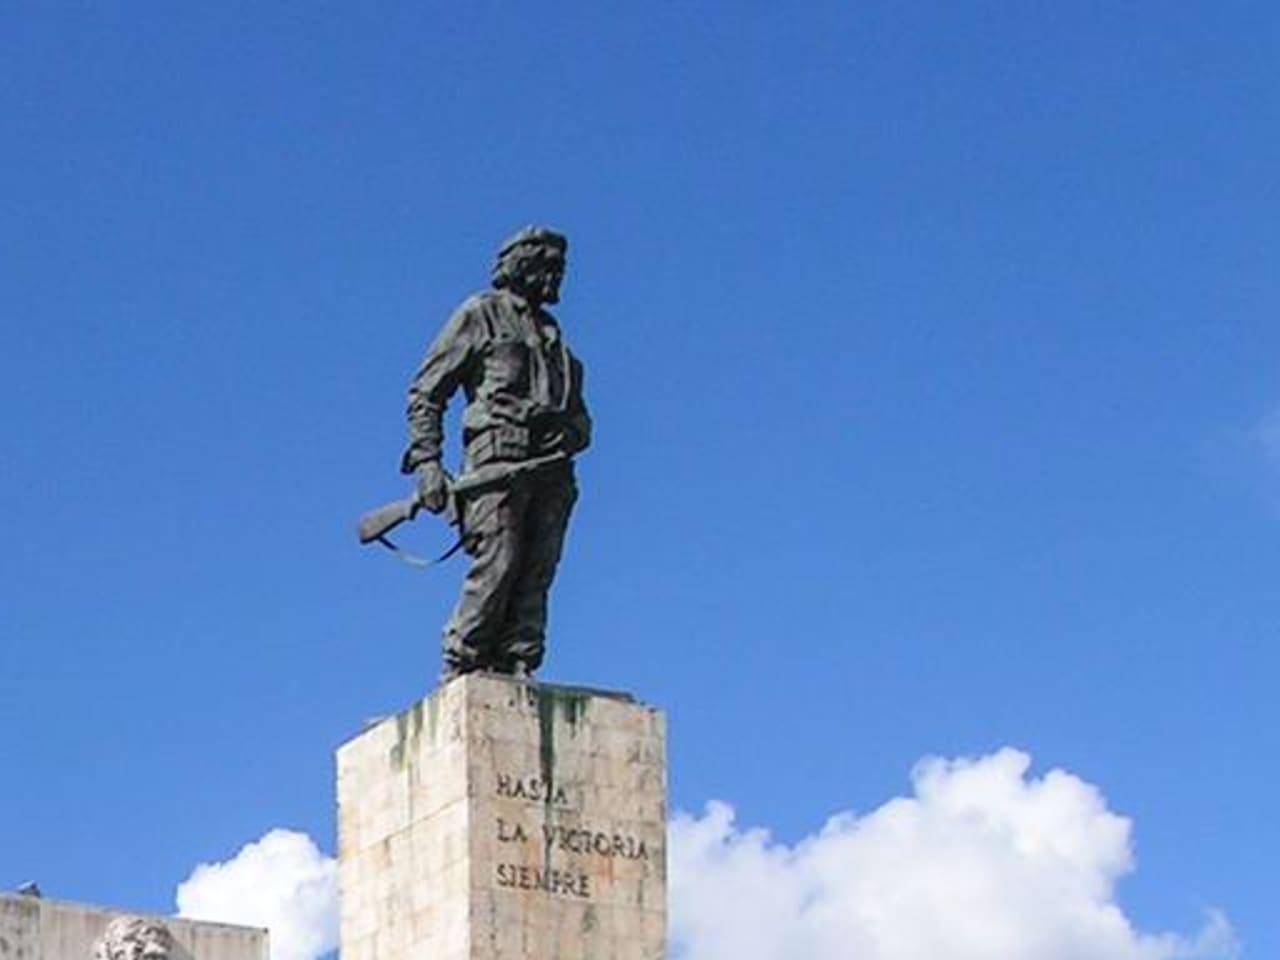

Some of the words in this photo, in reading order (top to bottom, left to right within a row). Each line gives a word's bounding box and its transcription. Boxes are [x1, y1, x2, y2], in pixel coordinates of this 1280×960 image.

[496, 773, 569, 804] HASTA
[496, 818, 528, 843] LA
[542, 825, 649, 860] VICTORIA
[496, 864, 590, 898] SIEMPRE
